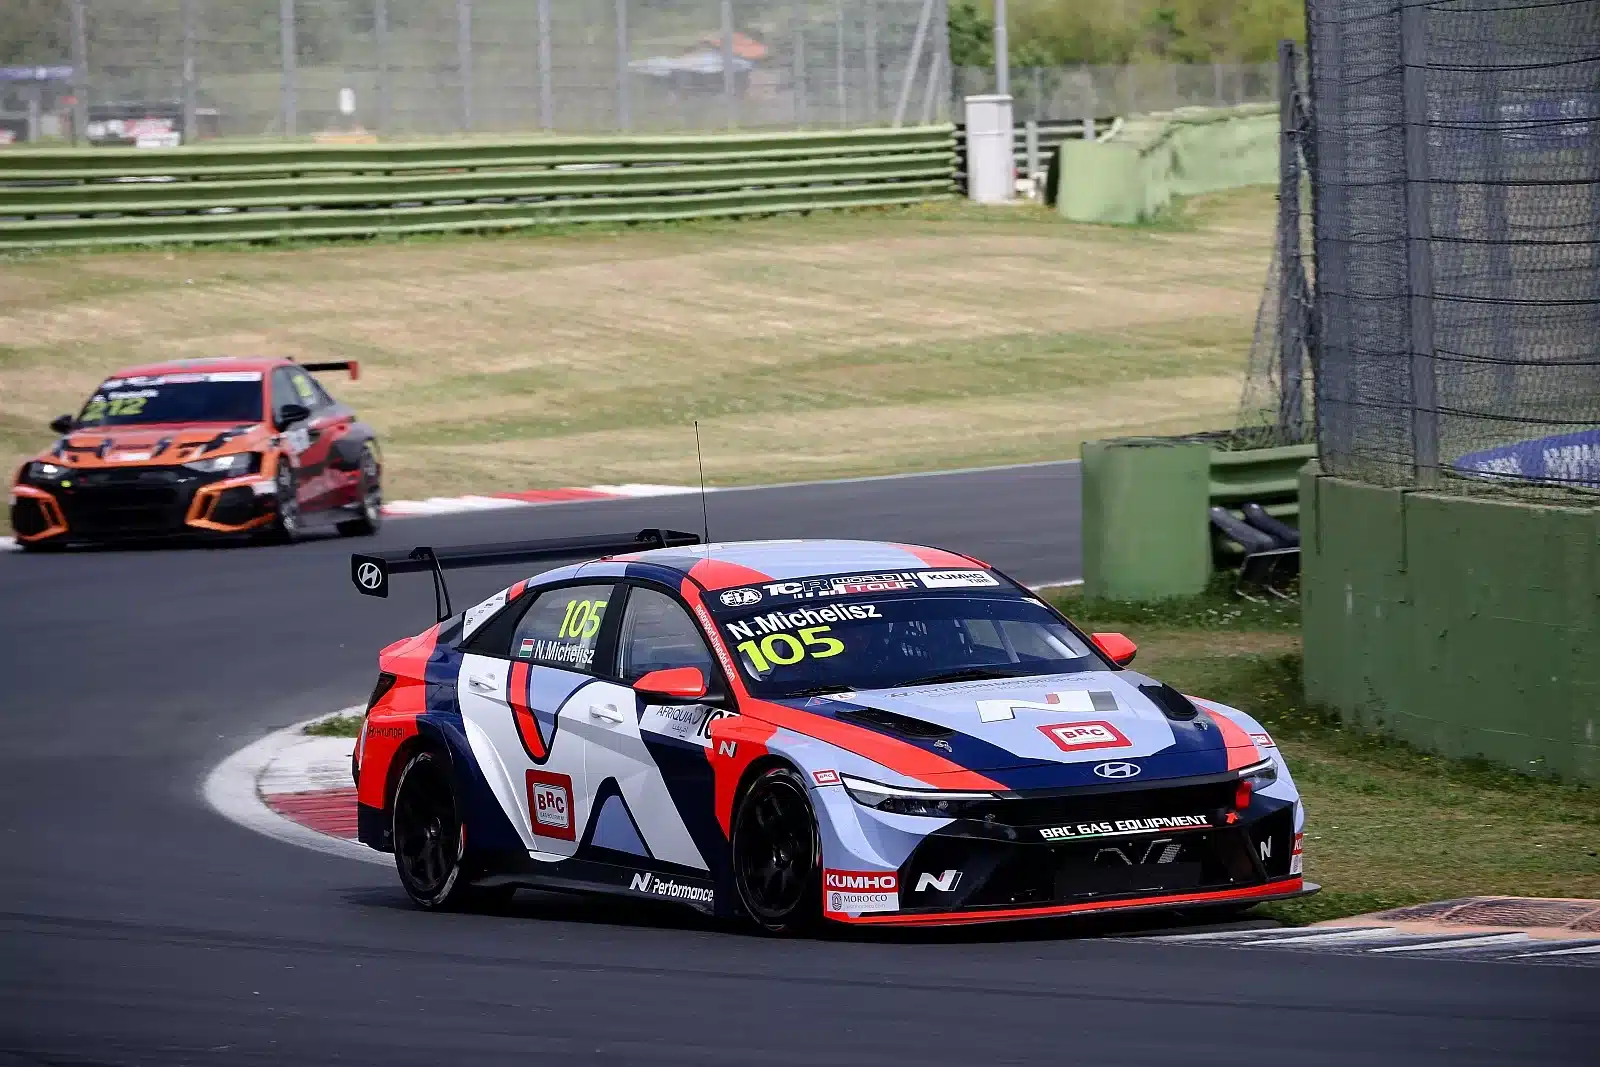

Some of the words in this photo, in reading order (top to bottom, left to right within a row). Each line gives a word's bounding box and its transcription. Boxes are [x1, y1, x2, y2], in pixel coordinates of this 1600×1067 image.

[762, 579, 830, 597] TCR
[835, 575, 899, 585] WORLD
[851, 581, 918, 592] TOUR
[721, 588, 761, 606] FIA
[558, 600, 608, 638] 105
[726, 603, 882, 640] N.Michelisz
[534, 639, 595, 664] N.Michelisz
[695, 604, 736, 682] motorsport.hyundai.com
[737, 625, 845, 672] 105
[656, 705, 693, 724] AFRIQUIA
[376, 727, 405, 738] HYUNDAI
[1062, 729, 1105, 739] BRC
[537, 791, 564, 813] BRC
[1039, 826, 1076, 839] BRC
[1077, 822, 1113, 834] GAS
[1115, 815, 1208, 831] EQUIPMENT
[652, 878, 714, 902] Performance
[826, 874, 896, 889] KUMHO
[843, 895, 888, 903] MOROCCO
